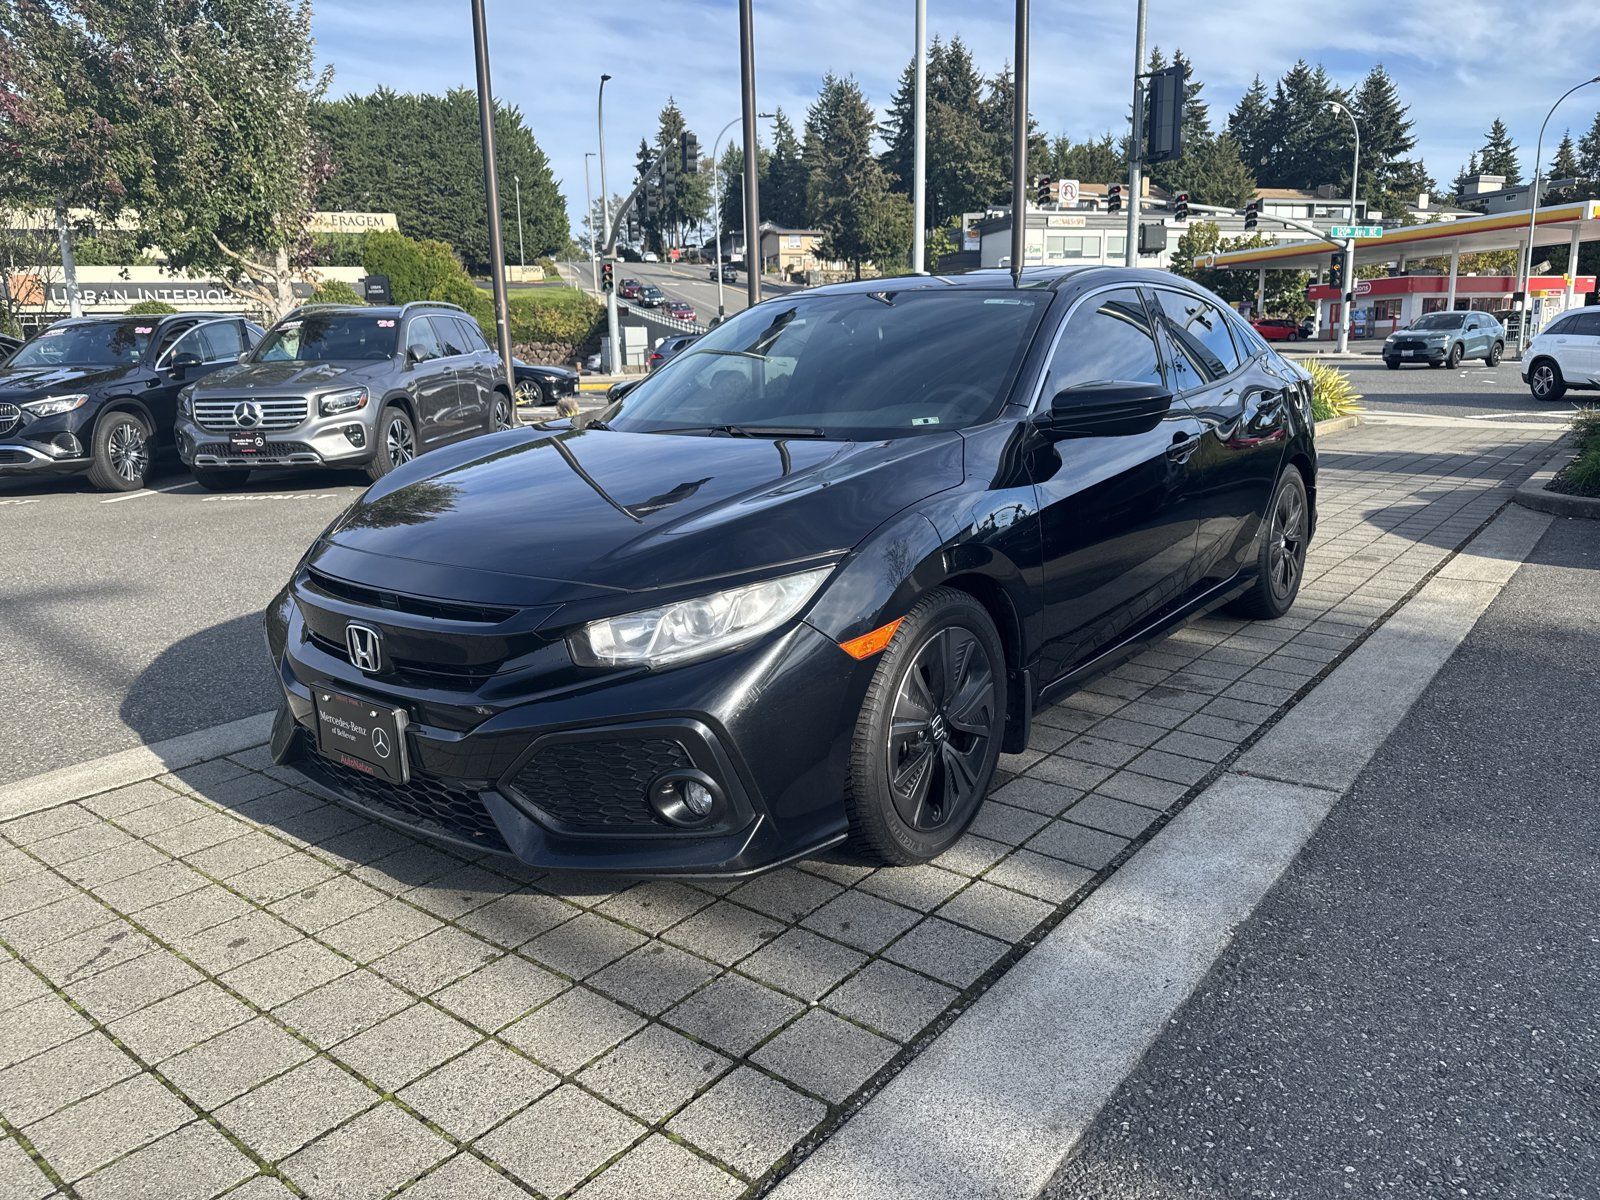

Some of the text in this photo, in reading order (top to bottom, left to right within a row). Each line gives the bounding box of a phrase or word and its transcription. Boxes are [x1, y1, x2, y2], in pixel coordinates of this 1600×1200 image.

[331, 214, 385, 227] ERAGEM
[1337, 226, 1351, 236] 120th
[1369, 226, 1378, 236] NE
[319, 710, 367, 736] Mercedes-Benz
[337, 728, 356, 741] Bellevue
[341, 754, 374, 775] AutoNation
